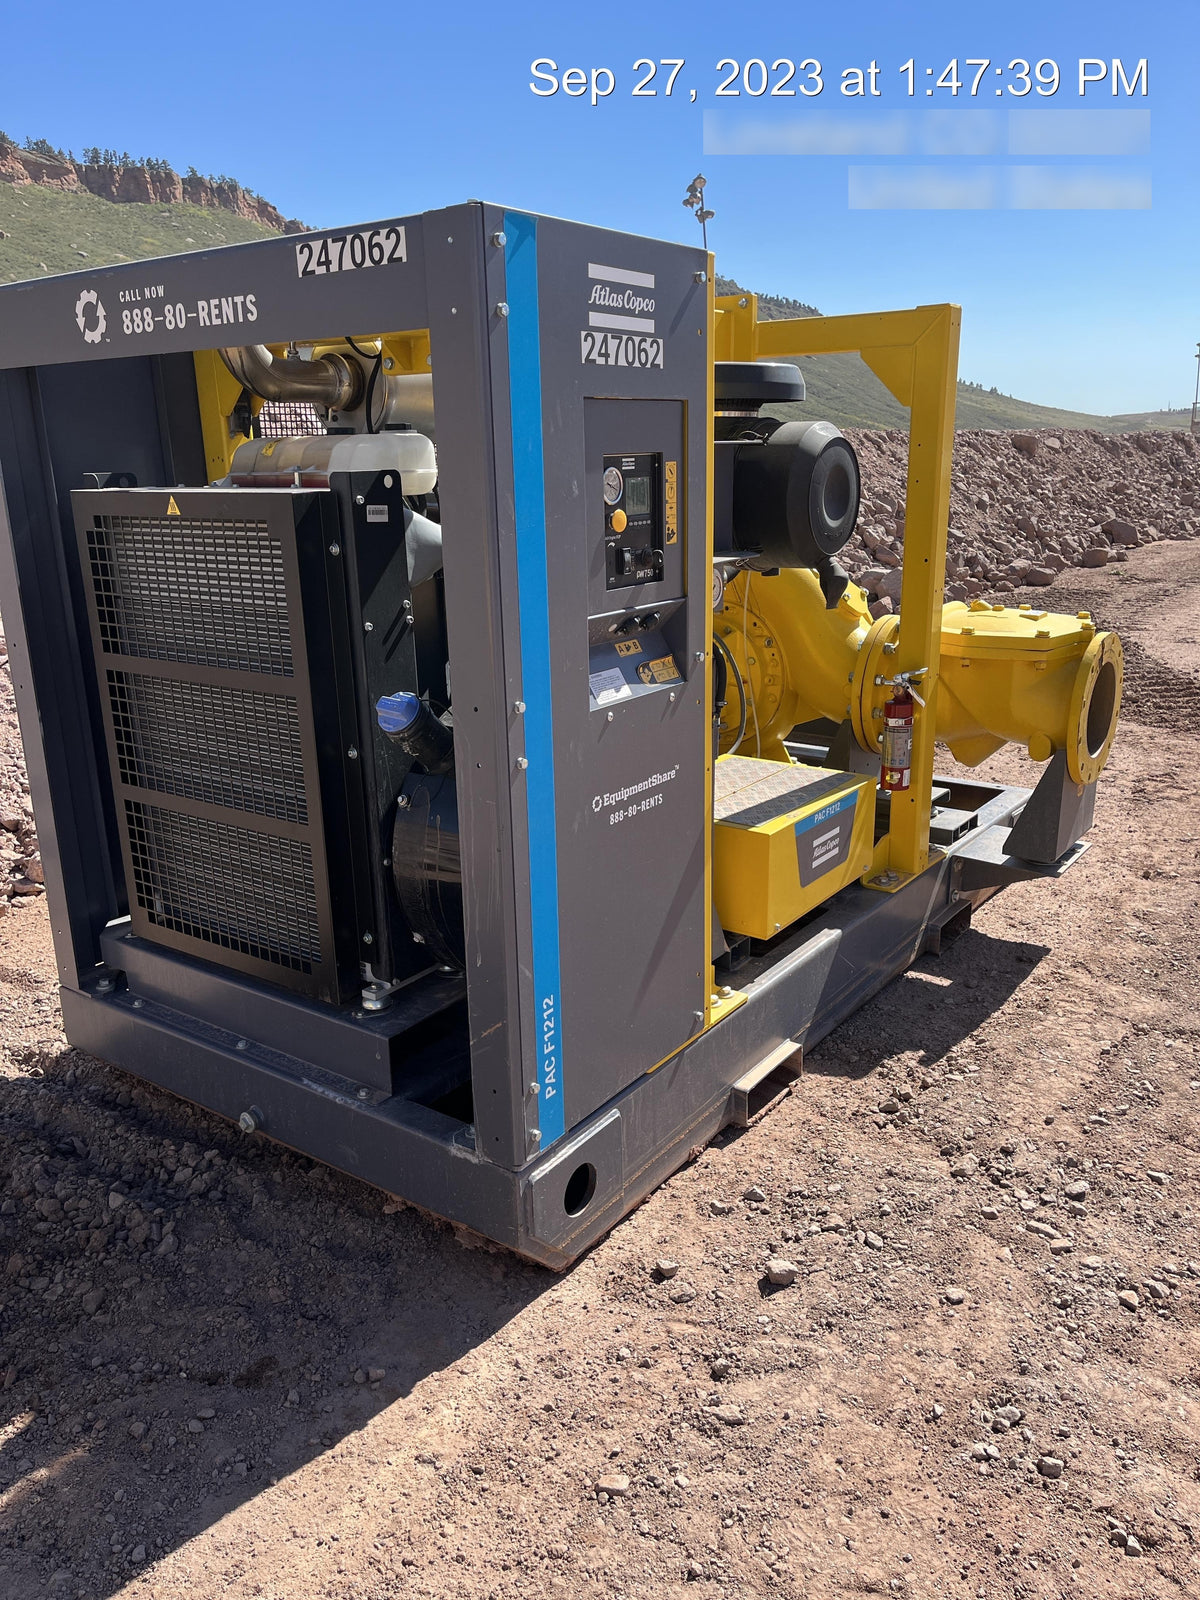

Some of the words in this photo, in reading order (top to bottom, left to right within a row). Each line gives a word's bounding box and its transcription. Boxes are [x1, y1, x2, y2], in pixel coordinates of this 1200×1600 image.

[298, 227, 403, 276] 247062
[119, 288, 141, 302] CALL
[144, 285, 165, 299] NOW
[588, 284, 623, 307] Atlas
[624, 290, 656, 314] Copco
[122, 294, 258, 335] 888-80-RENTS
[583, 332, 661, 368] 247062
[609, 793, 663, 825] 888-80-RENTS
[542, 994, 556, 1055] F1212
[544, 1056, 557, 1100] PAC
